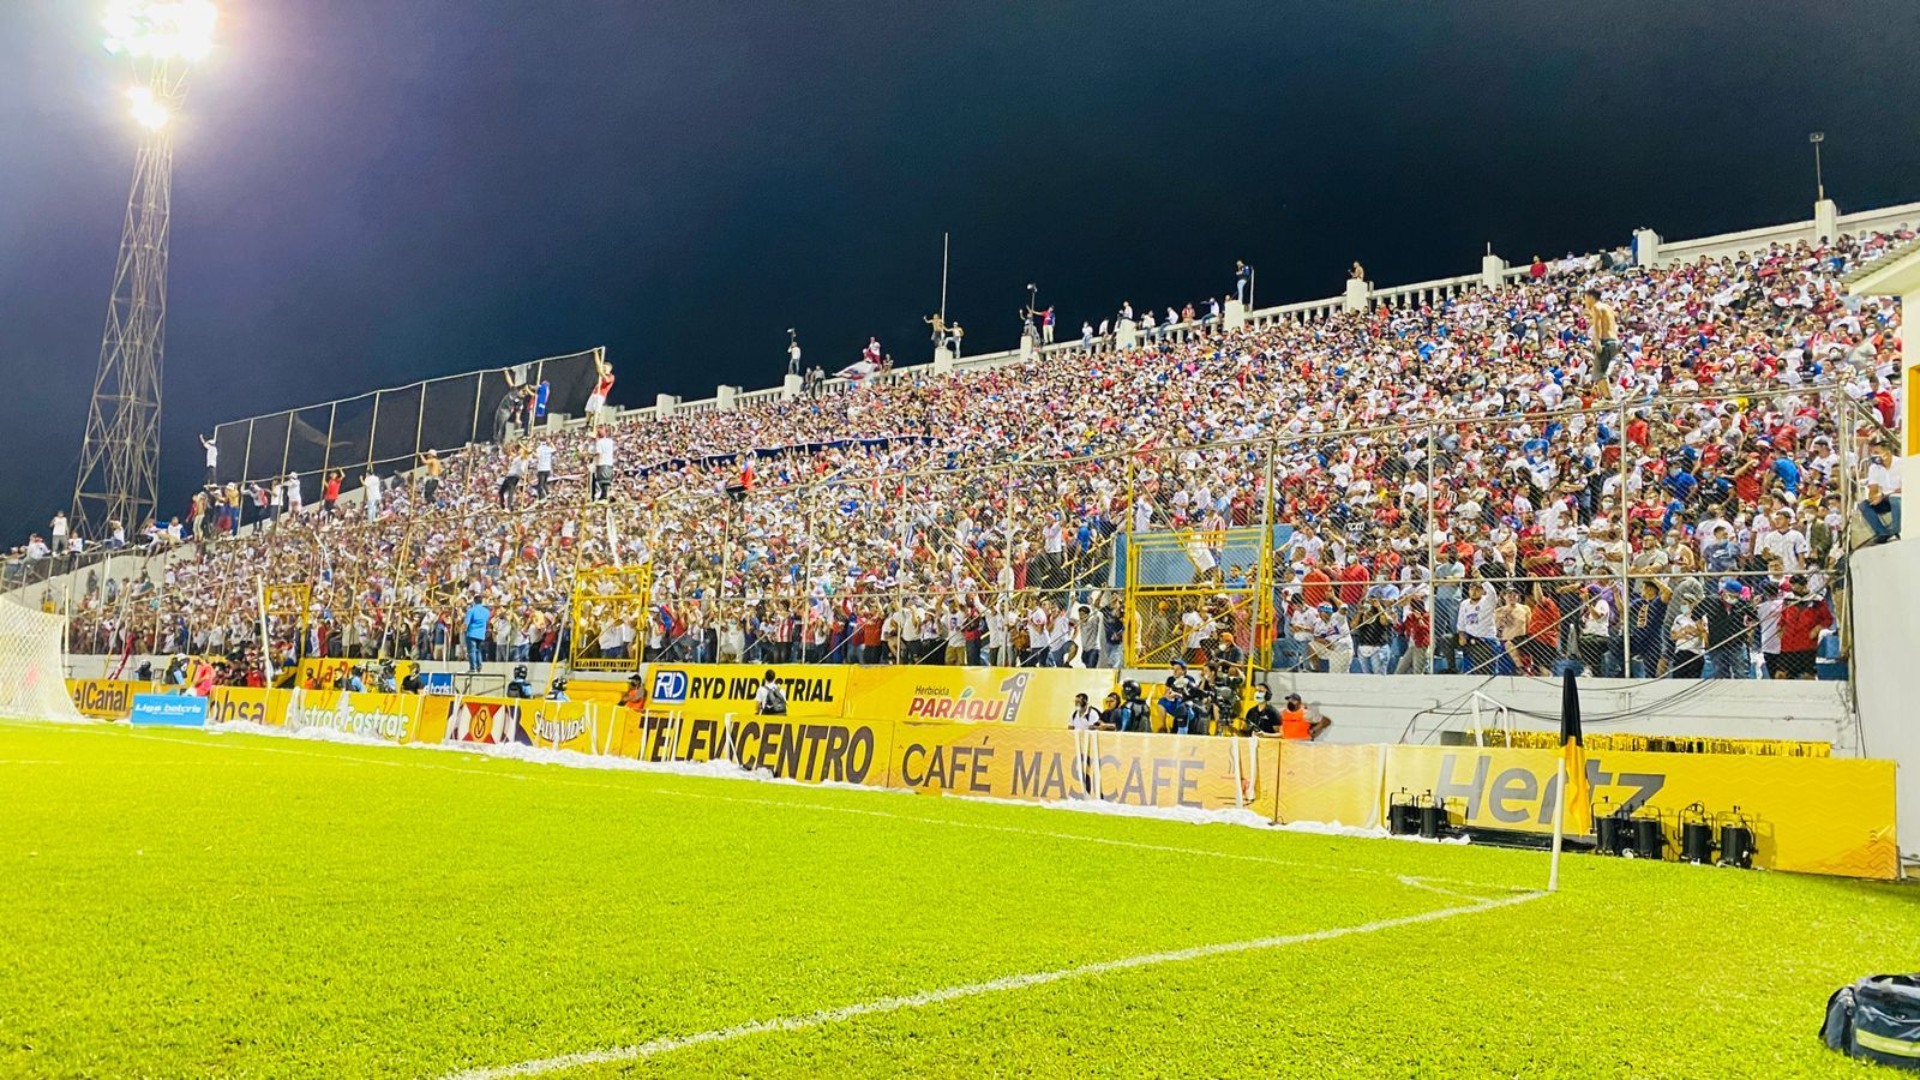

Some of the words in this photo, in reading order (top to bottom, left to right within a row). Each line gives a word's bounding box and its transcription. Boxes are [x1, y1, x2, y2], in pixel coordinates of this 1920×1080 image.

[690, 677, 726, 699] RYD
[728, 677, 834, 702] INDTRIAL
[638, 715, 875, 785] TELEVICENTRO
[901, 736, 995, 793] CAFÉ
[1010, 746, 1205, 809] MASCAFÉ
[1434, 753, 1666, 824] Hertz
